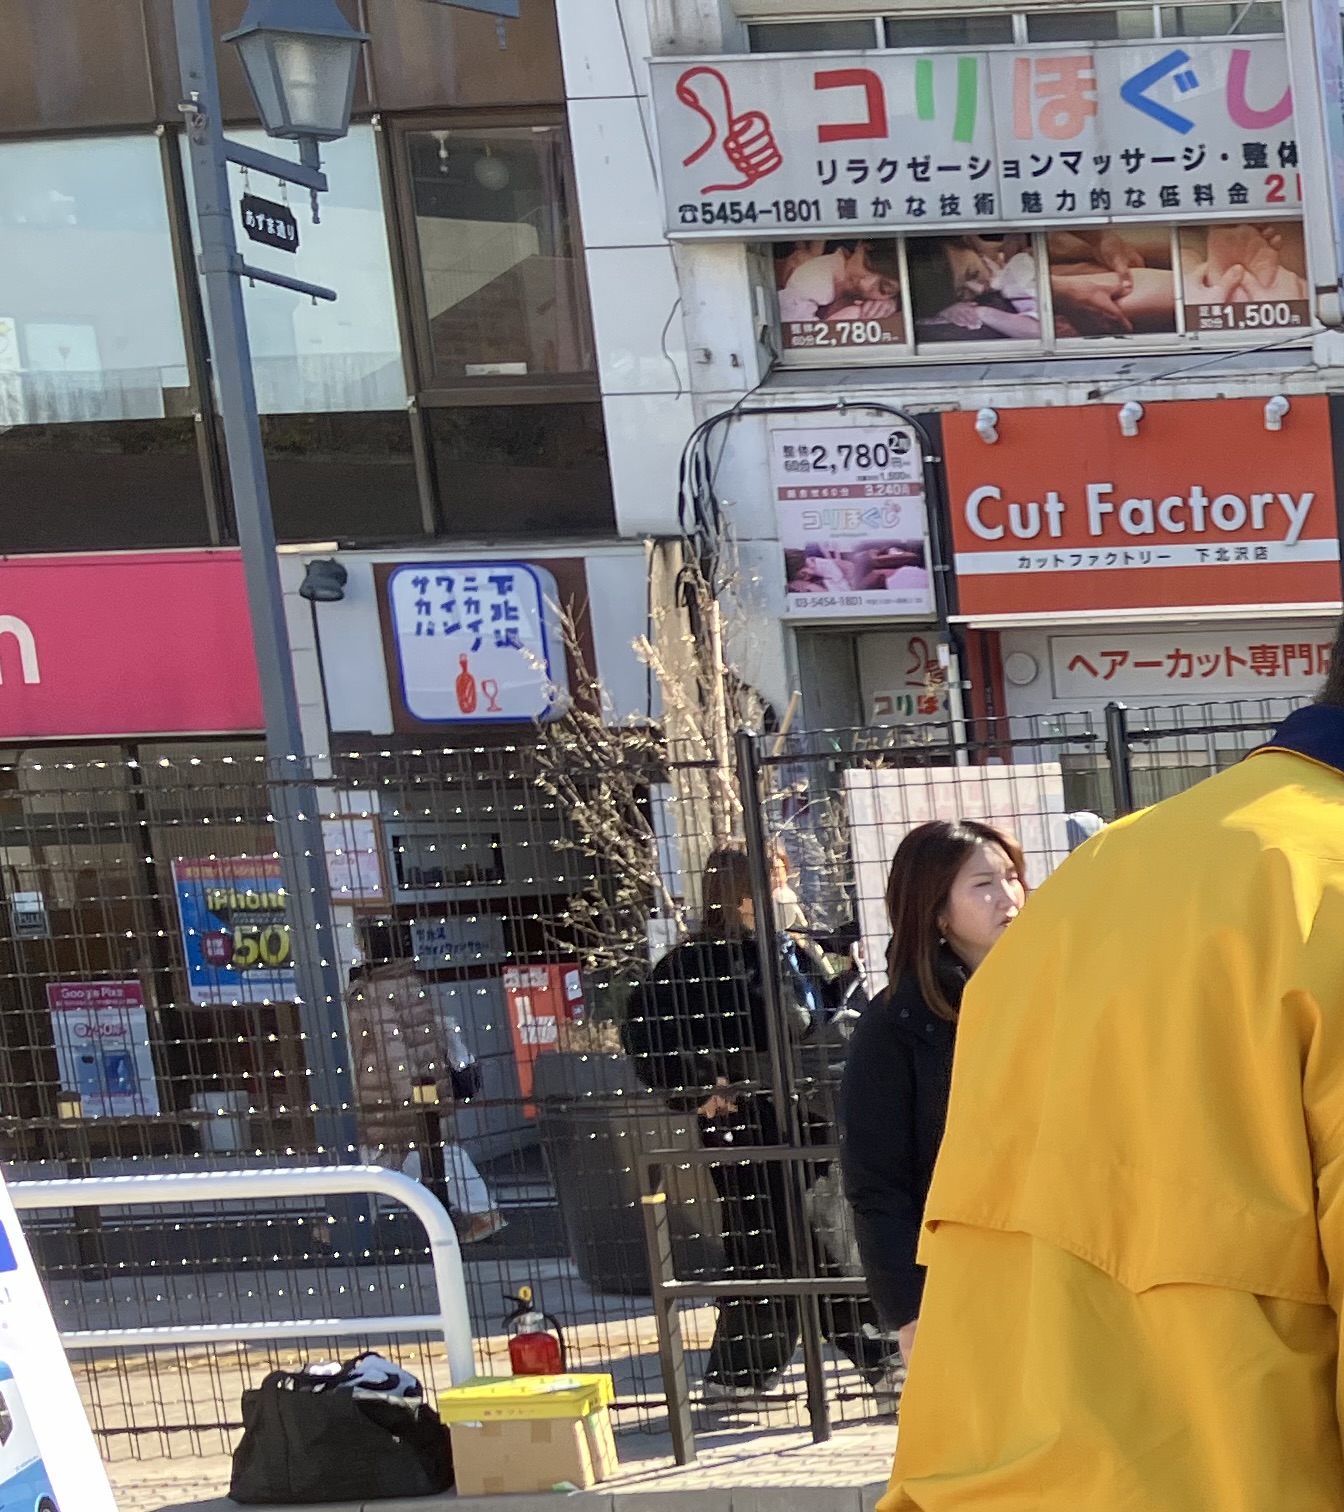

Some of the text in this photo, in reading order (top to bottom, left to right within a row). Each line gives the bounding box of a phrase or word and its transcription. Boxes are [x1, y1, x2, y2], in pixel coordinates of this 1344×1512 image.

[836, 192, 995, 220] 確かな技術
[1021, 181, 1250, 215] 魅力的な低料金
[1264, 173, 1302, 204] 2
[245, 208, 295, 241] あずま通り
[965, 482, 1315, 546] Cut Factory
[1018, 546, 1269, 570] カットファクトリー 下北沢店
[875, 693, 950, 717] コリほ
